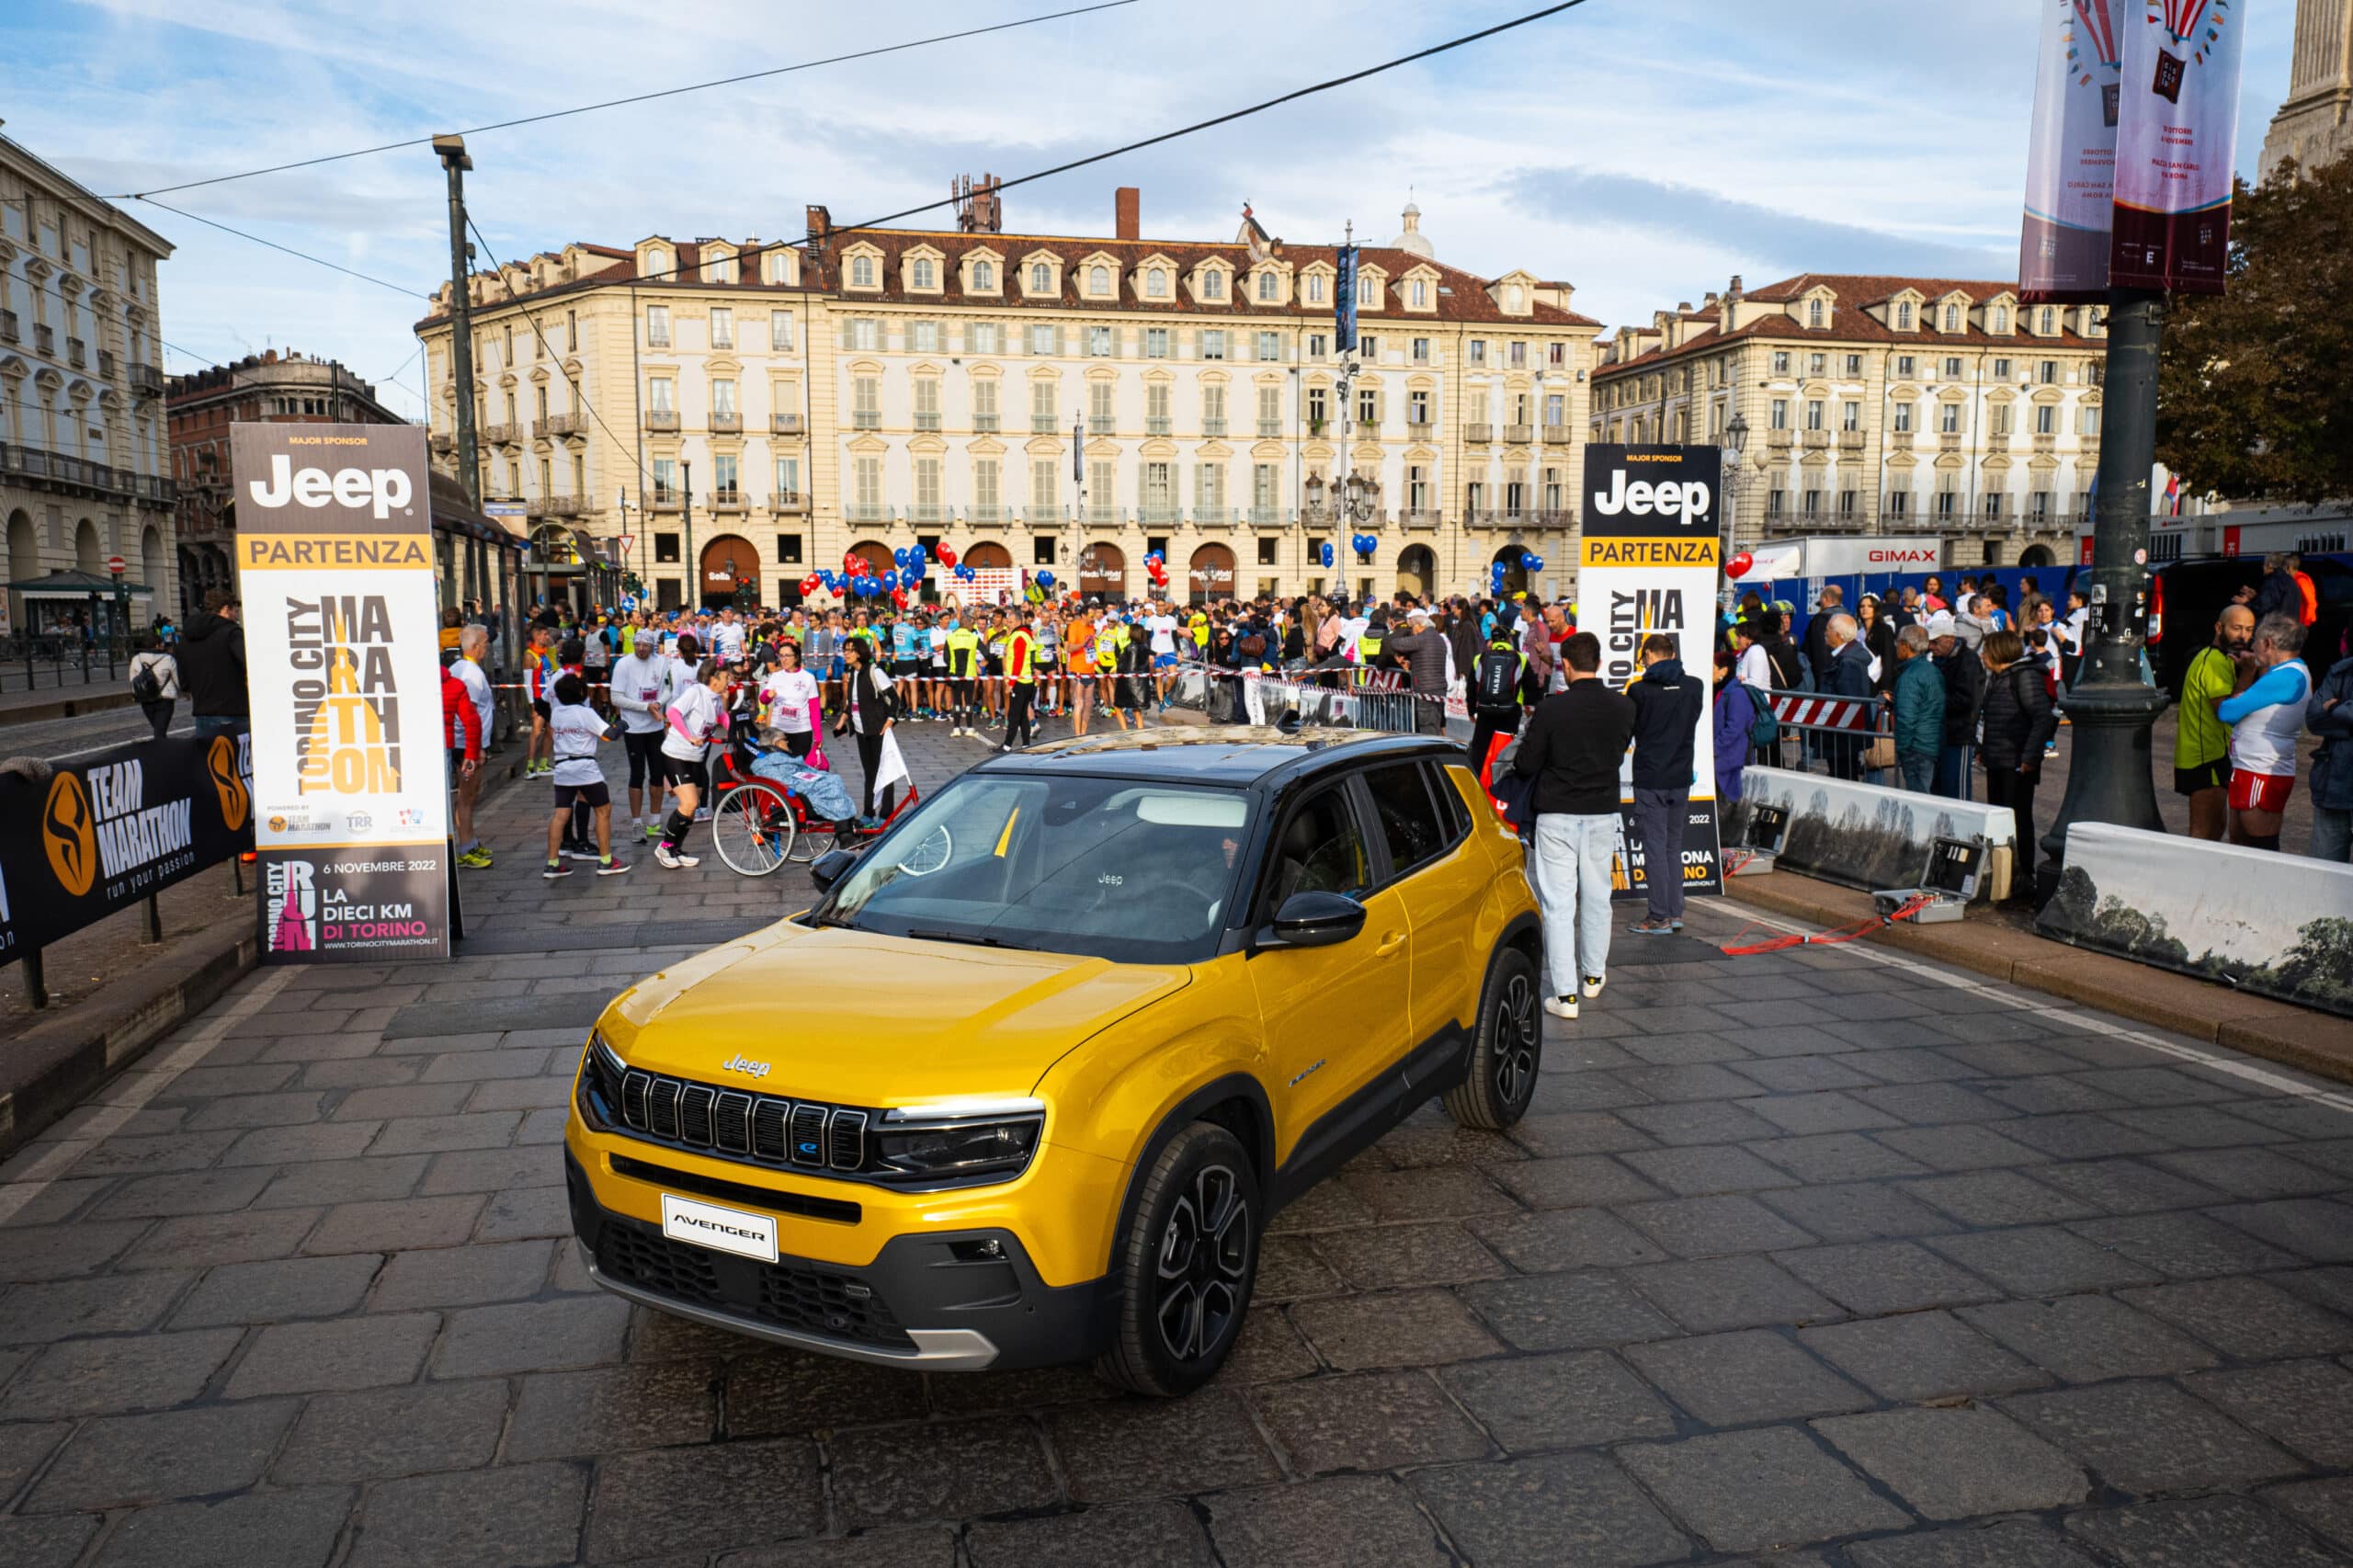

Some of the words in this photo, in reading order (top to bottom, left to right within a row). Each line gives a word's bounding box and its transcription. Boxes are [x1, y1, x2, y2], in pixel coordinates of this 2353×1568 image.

[290, 437, 321, 445] MAJOR
[324, 437, 368, 446] SPONSOR
[1626, 454, 1650, 462] MAJOR
[1652, 455, 1682, 463] SPONSOR
[250, 454, 412, 519] Jeep
[1595, 469, 1710, 525] Jeep
[250, 540, 426, 563] PARTENZA
[1590, 542, 1713, 562] PARTENZA
[1869, 550, 1936, 562] GIMAX
[286, 596, 324, 669] CITY
[1608, 590, 1635, 652] CITY
[292, 679, 331, 796] TORINO
[87, 758, 142, 823] TEAM
[346, 815, 372, 828] TRR
[1629, 817, 1635, 826] 6
[1688, 814, 1710, 824] 2022
[96, 798, 191, 879] MARATHON
[107, 881, 125, 901] run
[131, 869, 153, 893] your
[158, 851, 195, 880] passion
[267, 862, 283, 895] CITY
[324, 865, 331, 874] 6
[335, 861, 404, 873] NOVEMBRE
[408, 860, 437, 871] 2022
[1098, 871, 1123, 887] Jeep
[323, 889, 347, 903] LA
[323, 905, 374, 921] DIECI
[381, 903, 412, 919] KM
[267, 896, 284, 952] TORINO
[323, 924, 343, 939] DI
[349, 921, 426, 937] TORINO
[324, 937, 438, 949] WWW.TORINOCITYMARATHON.IT
[722, 1053, 771, 1079] Jeep
[674, 1214, 765, 1242] AVENGER
